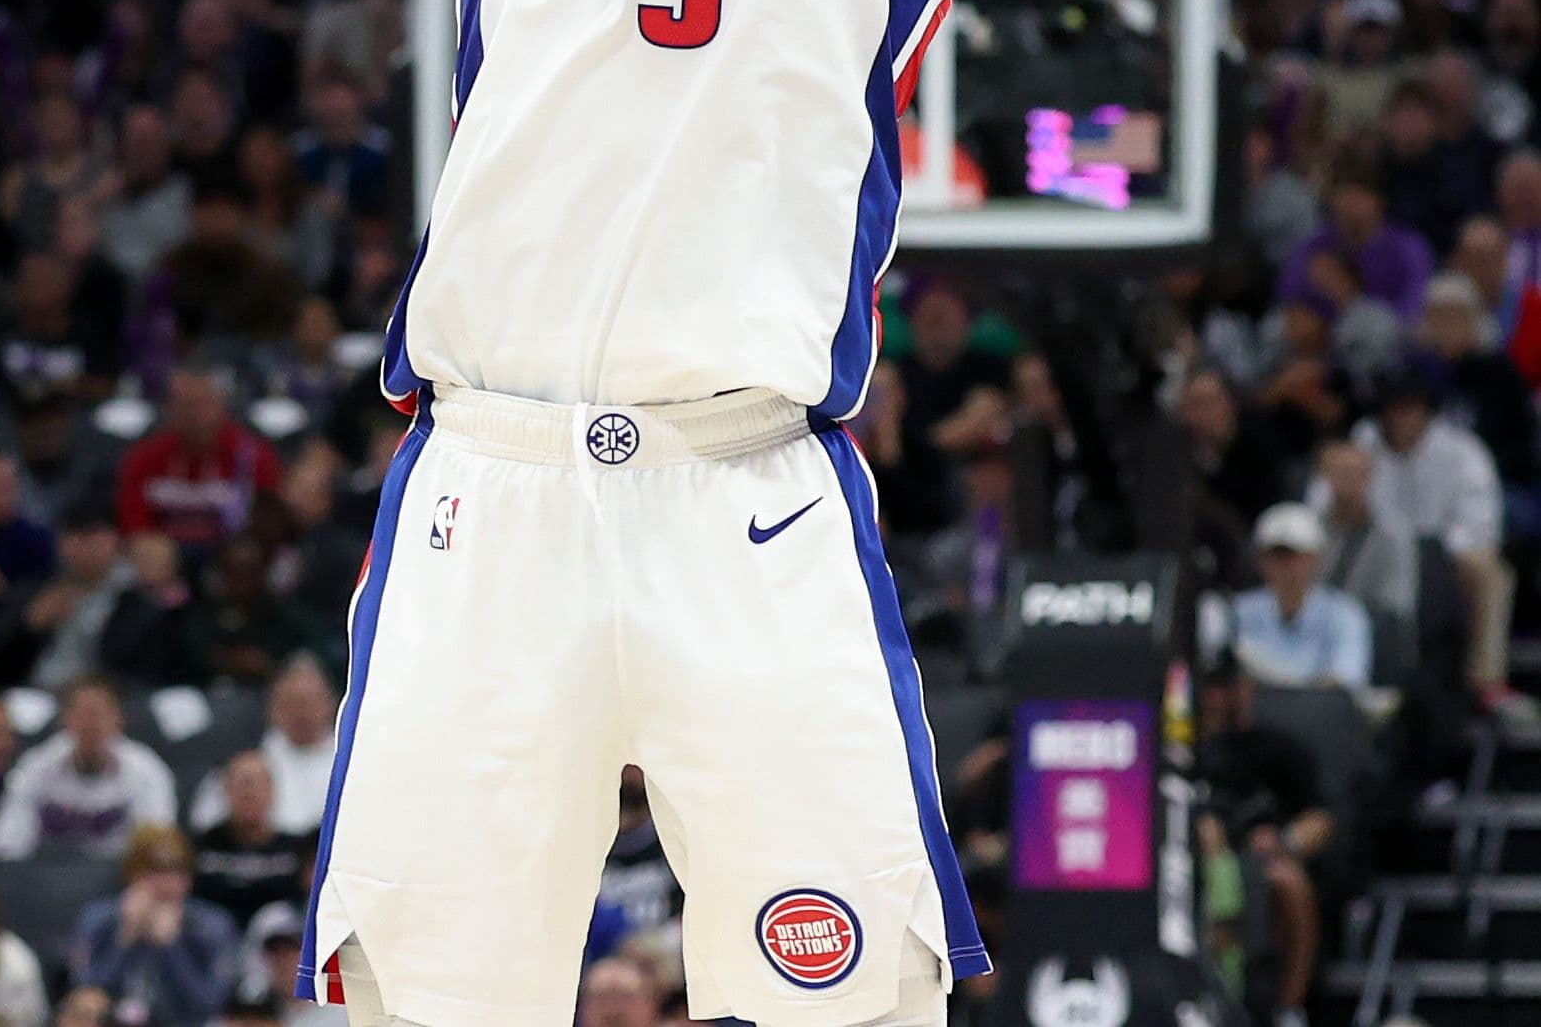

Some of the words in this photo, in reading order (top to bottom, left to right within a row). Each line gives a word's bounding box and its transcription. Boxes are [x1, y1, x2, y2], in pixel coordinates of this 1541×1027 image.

[1021, 580, 1155, 626] PATH
[773, 918, 837, 940] DETROIT
[777, 935, 844, 956] PISTONS
